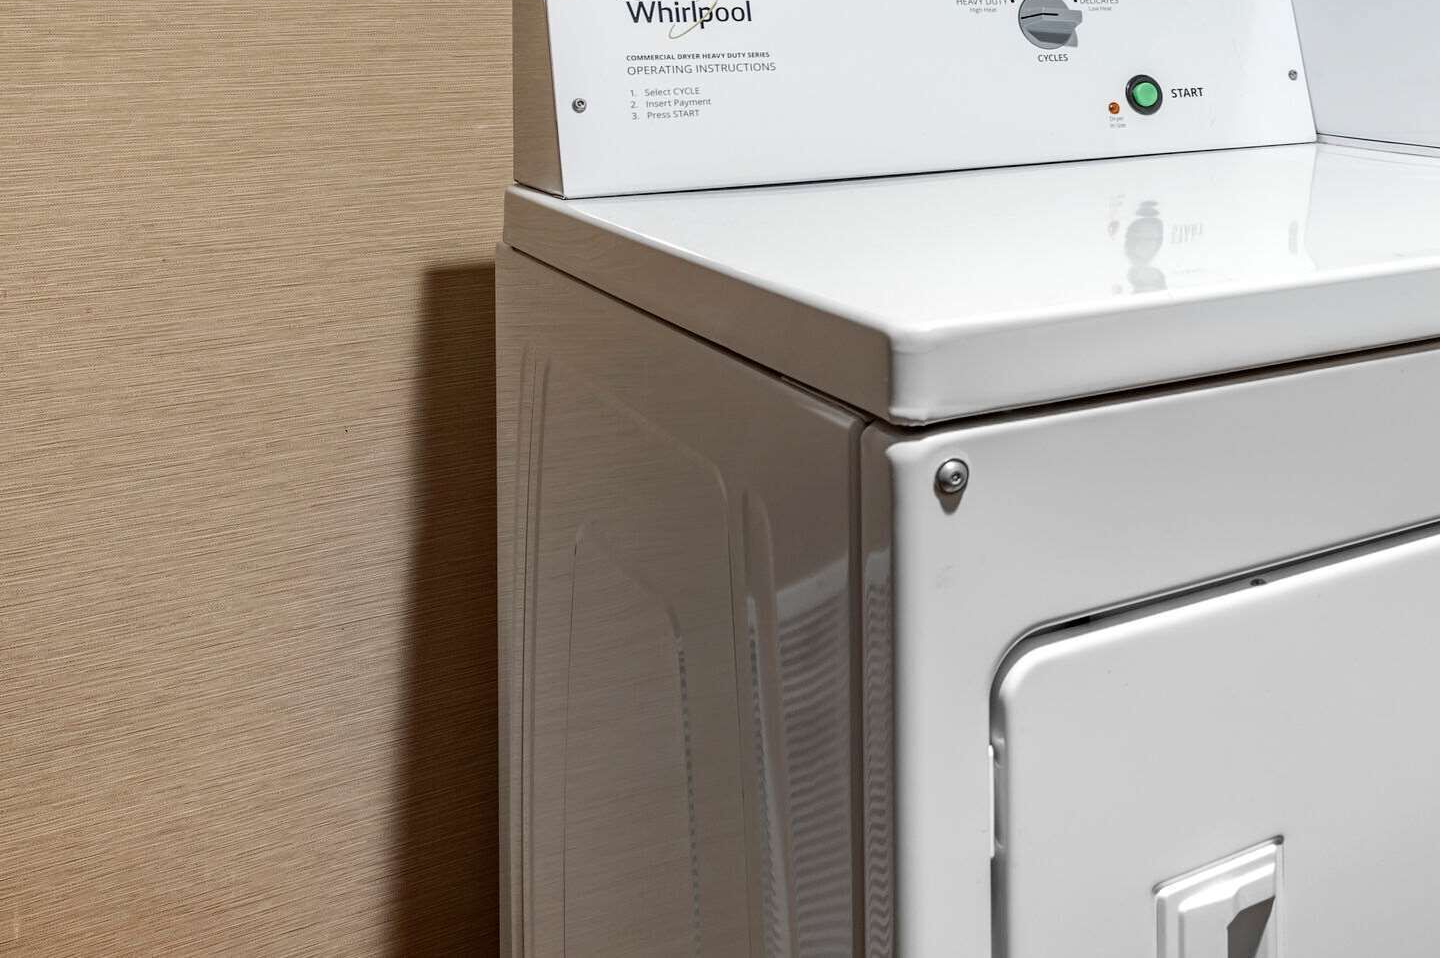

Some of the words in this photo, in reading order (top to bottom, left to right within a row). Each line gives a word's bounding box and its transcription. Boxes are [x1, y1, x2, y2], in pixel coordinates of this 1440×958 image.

[625, 0, 753, 30] Whirlpool
[1037, 53, 1069, 62] CYCLES
[626, 64, 693, 76] OPERATING
[695, 62, 777, 74] INSTRUCTIONS
[644, 87, 671, 97] Select
[672, 87, 700, 96] CYCLE
[1170, 87, 1204, 99] START
[646, 99, 672, 108] Insert
[673, 98, 712, 109] Payment
[647, 111, 671, 120] Press
[672, 109, 700, 118] START
